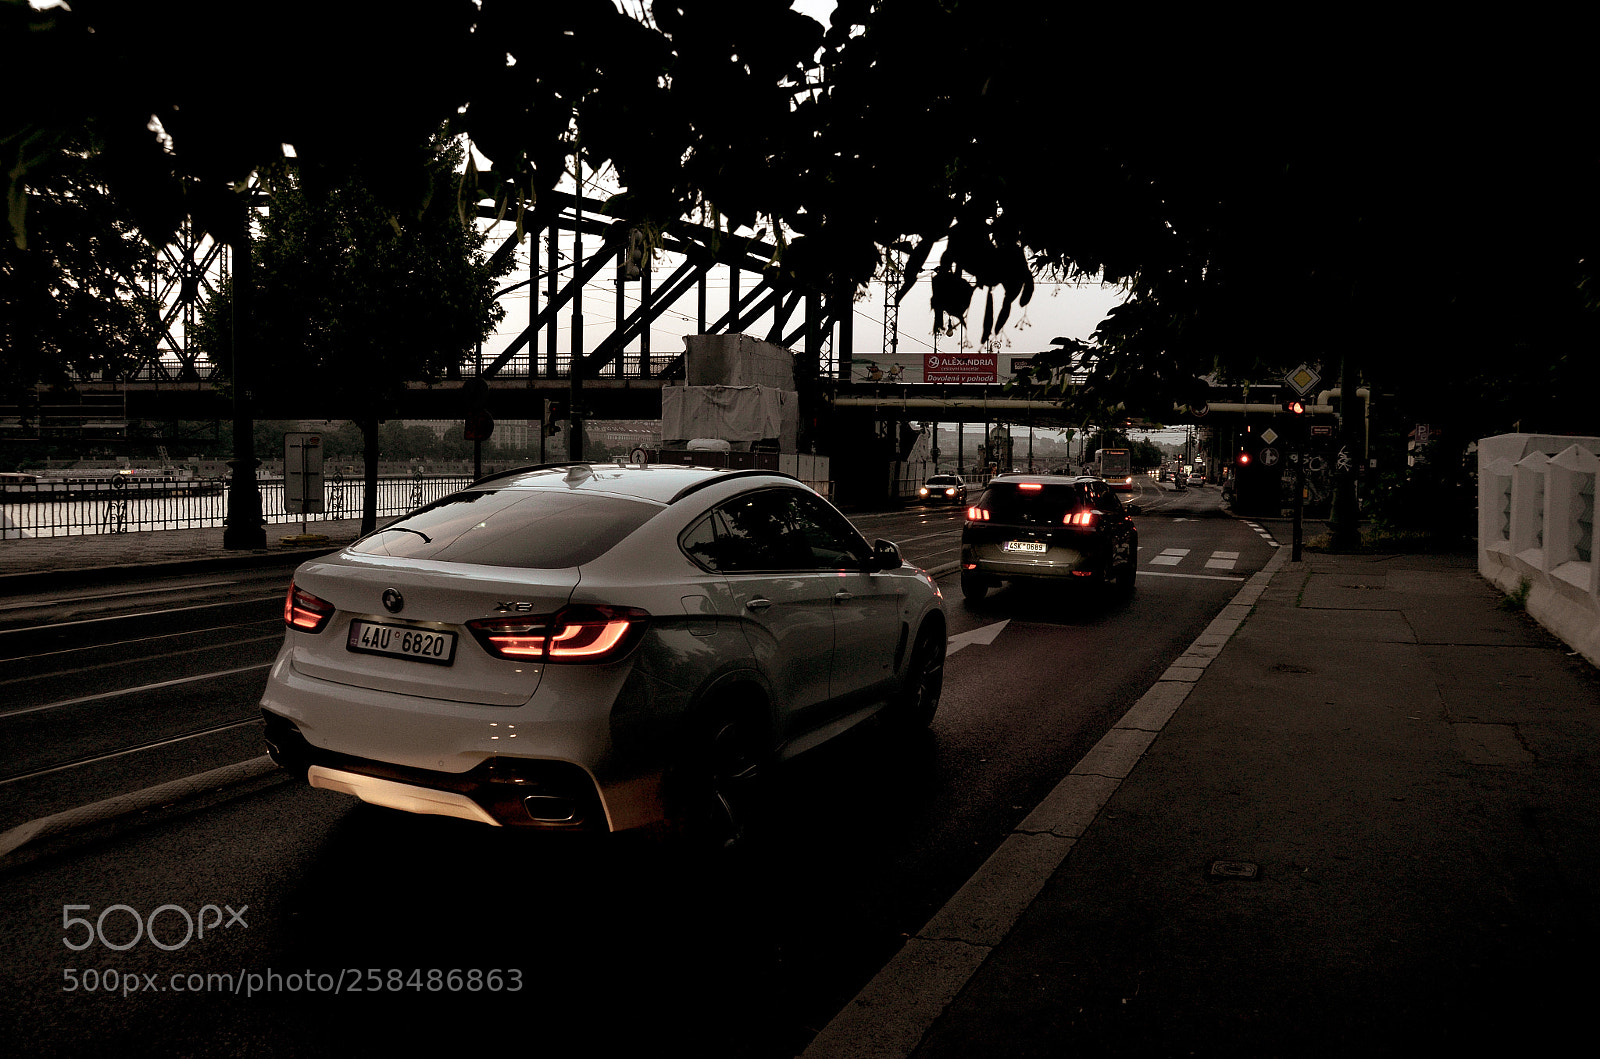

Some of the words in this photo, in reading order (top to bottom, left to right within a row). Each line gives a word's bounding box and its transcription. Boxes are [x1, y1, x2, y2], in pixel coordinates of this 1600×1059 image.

[927, 374, 960, 382] Dovolená
[361, 626, 392, 649] 4AU
[402, 631, 445, 657] 6820
